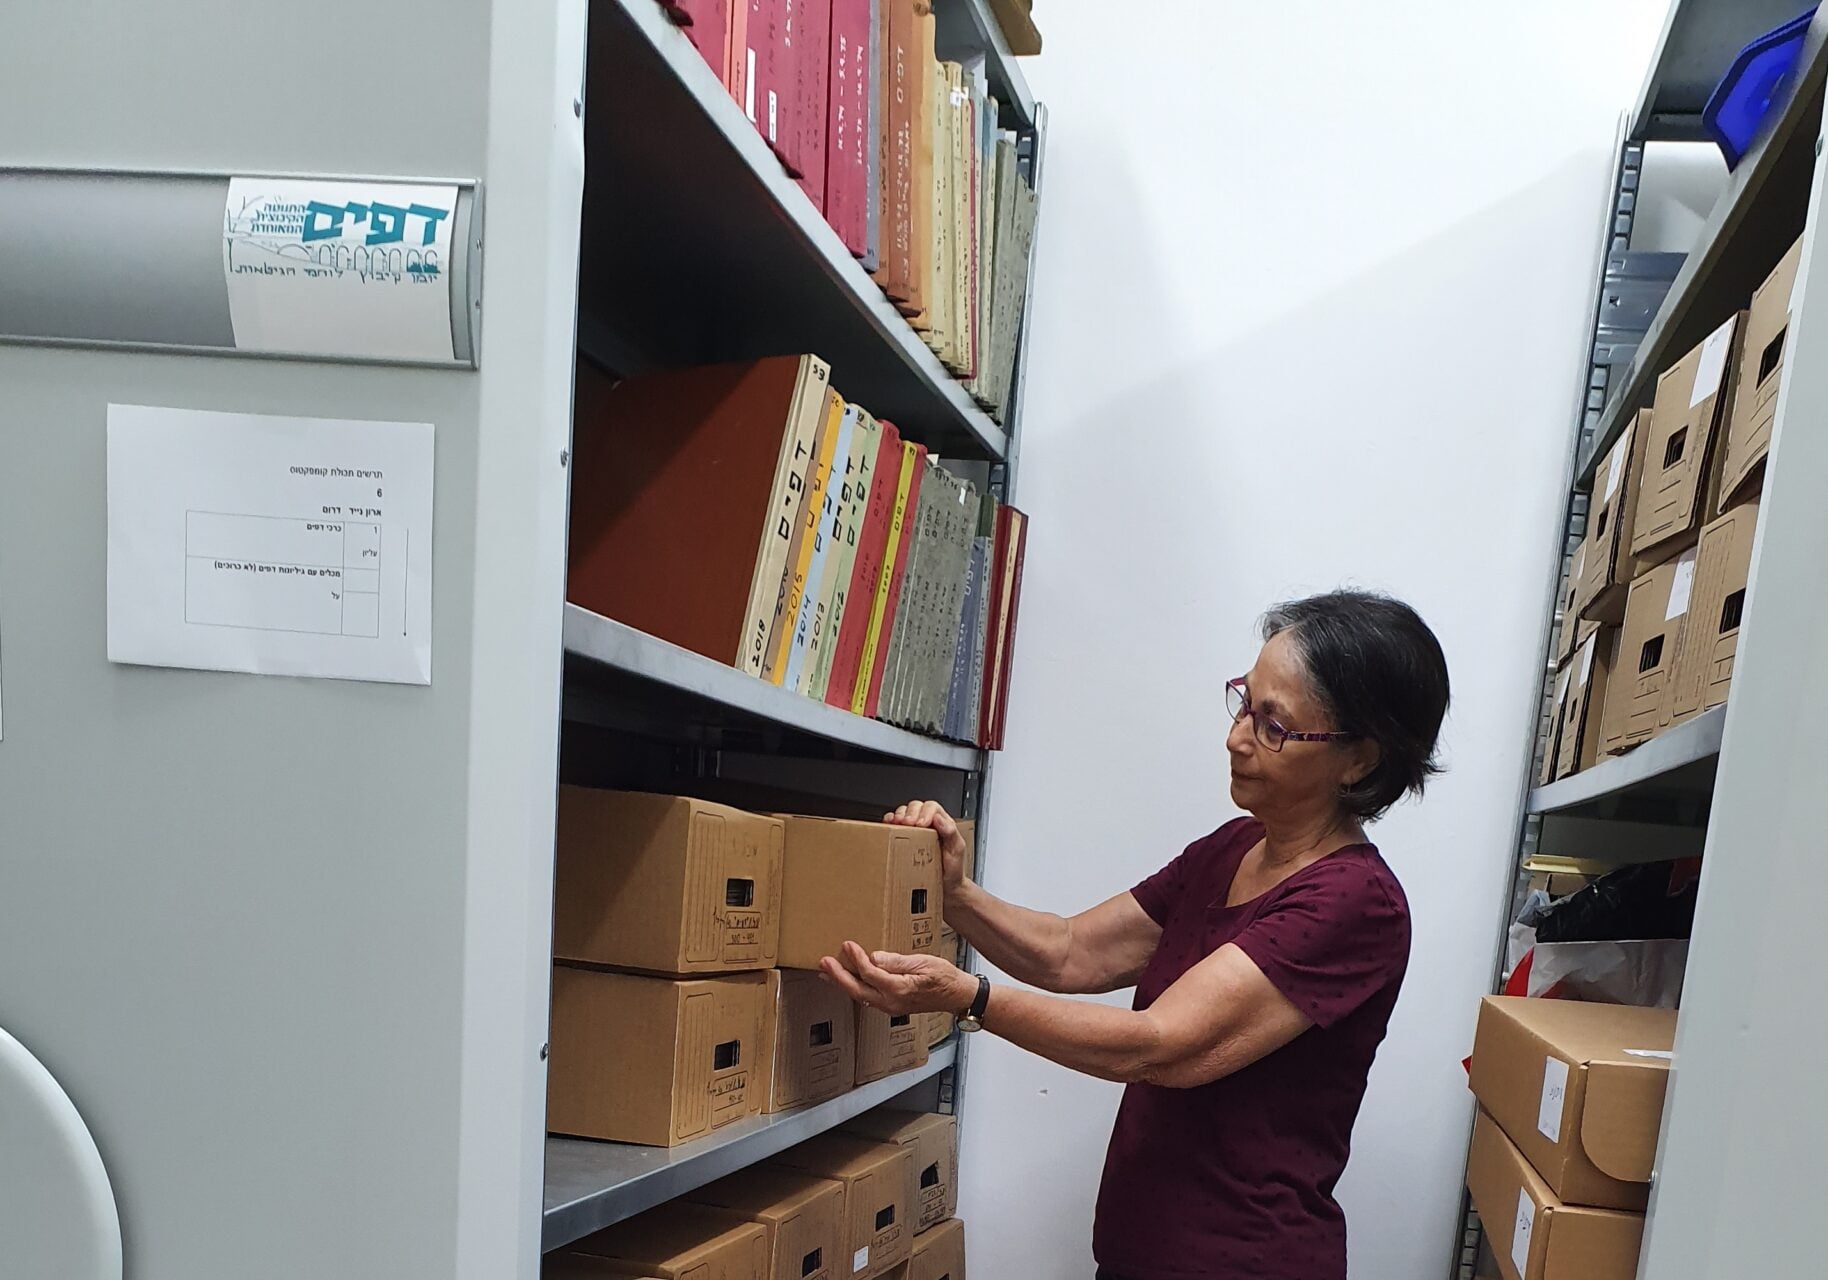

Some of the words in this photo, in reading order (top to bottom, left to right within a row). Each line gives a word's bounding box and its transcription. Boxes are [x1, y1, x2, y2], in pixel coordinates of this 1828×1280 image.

[263, 202, 306, 213] התנועה
[255, 211, 304, 224] הקיבוצית
[250, 223, 304, 234] המאוחדת
[302, 200, 449, 247] דפים
[304, 267, 344, 278] לוחמי
[360, 269, 401, 285] קיבוץ
[411, 273, 438, 284] יומן
[812, 364, 826, 381] 53
[289, 465, 328, 477] קומפקטוס
[330, 467, 354, 477] תכולת
[356, 469, 383, 479] תרשים
[376, 488, 383, 498] 6
[777, 440, 807, 540] דפים
[831, 455, 855, 542] דפים
[846, 454, 870, 547] דפים
[322, 505, 341, 515] דרום
[349, 507, 363, 516] נייד
[365, 508, 382, 518] ארון
[306, 523, 324, 532] דפים
[326, 525, 342, 533] כרכי
[362, 549, 378, 558] עליון
[214, 560, 242, 570] כרוכים)
[243, 563, 256, 573] (לא
[258, 565, 276, 574] דפים
[278, 566, 305, 576] גיליונות
[307, 569, 317, 577] עם
[319, 569, 341, 578] מכלים
[331, 592, 340, 600] על
[787, 572, 803, 627] 2015
[832, 591, 844, 637] 2012
[797, 595, 812, 647] 2014
[811, 602, 825, 651] 2013
[751, 618, 766, 668] 2018
